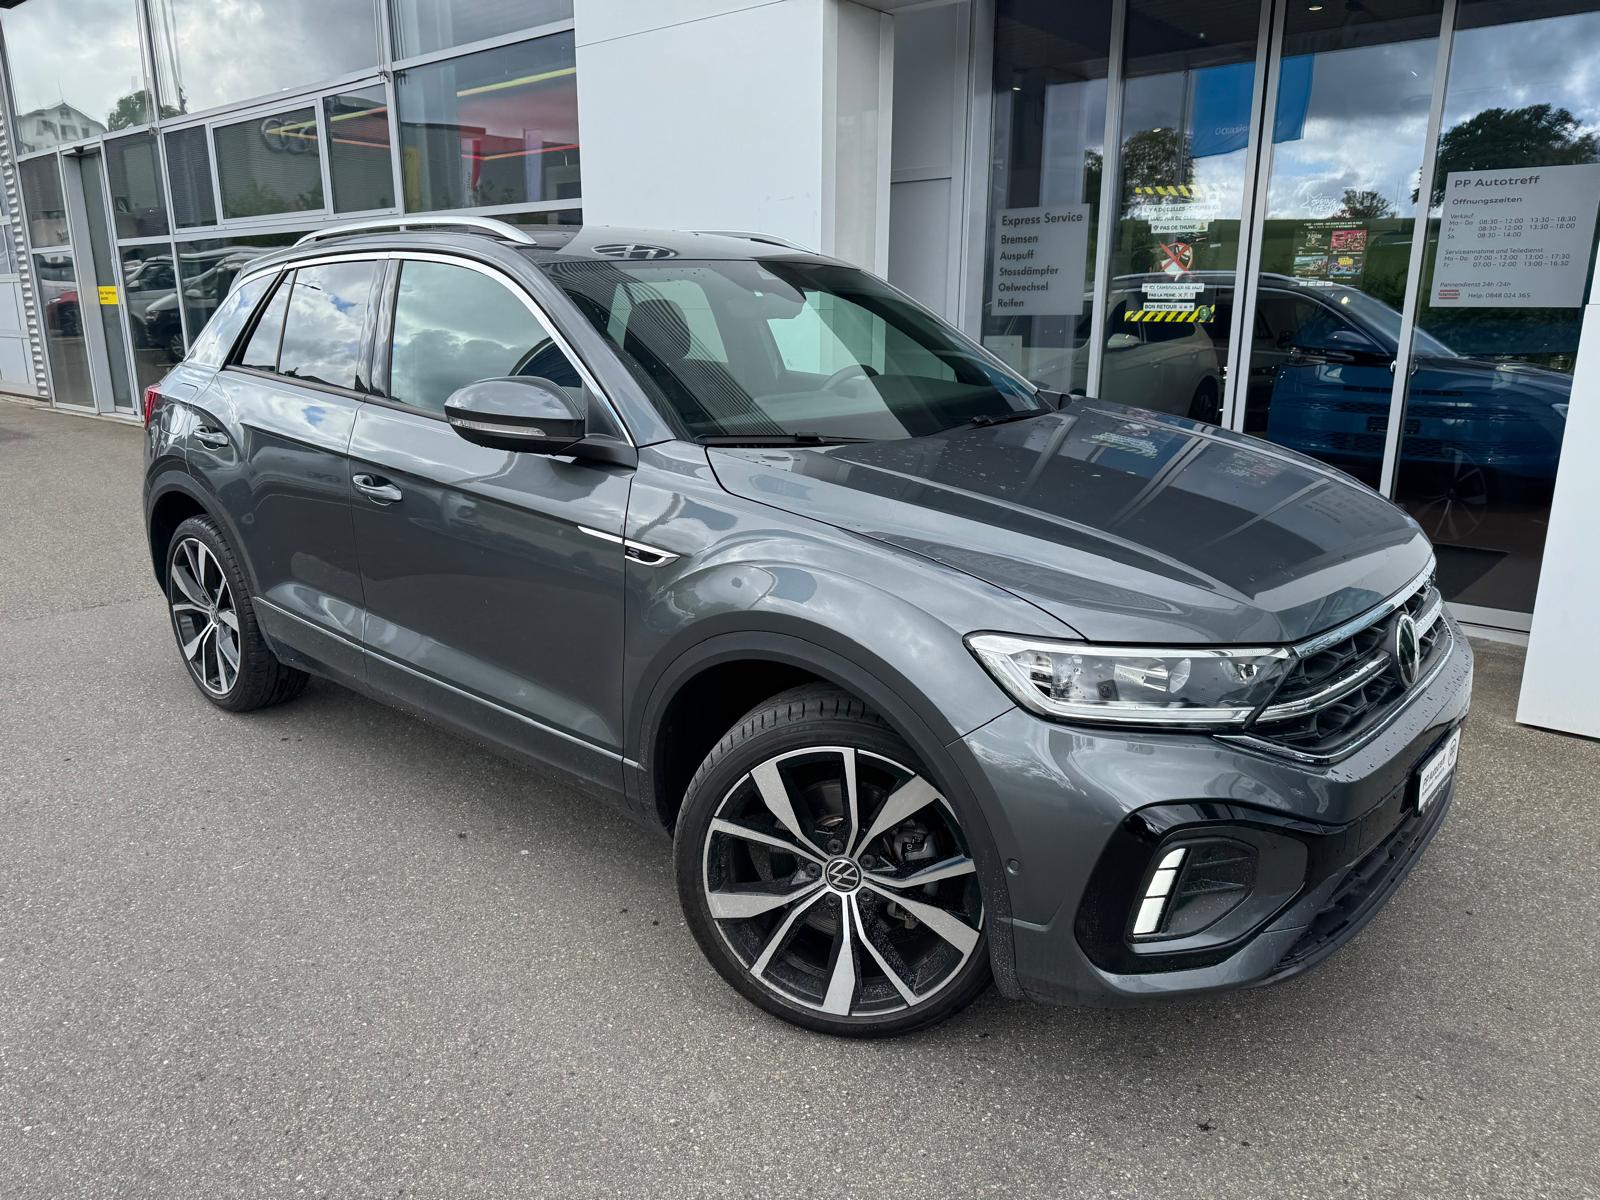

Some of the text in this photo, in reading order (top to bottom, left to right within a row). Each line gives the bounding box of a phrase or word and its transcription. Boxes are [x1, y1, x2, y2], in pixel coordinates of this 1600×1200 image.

[1454, 176, 1540, 188] PP Autotreff
[1002, 212, 1083, 227] Express Service
[1001, 235, 1038, 244] Bremsen
[1000, 250, 1034, 261] Auspuff
[1000, 265, 1059, 276] Stossdämpfer
[998, 281, 1048, 292] Oelwechsel
[997, 298, 1024, 308] Reifen
